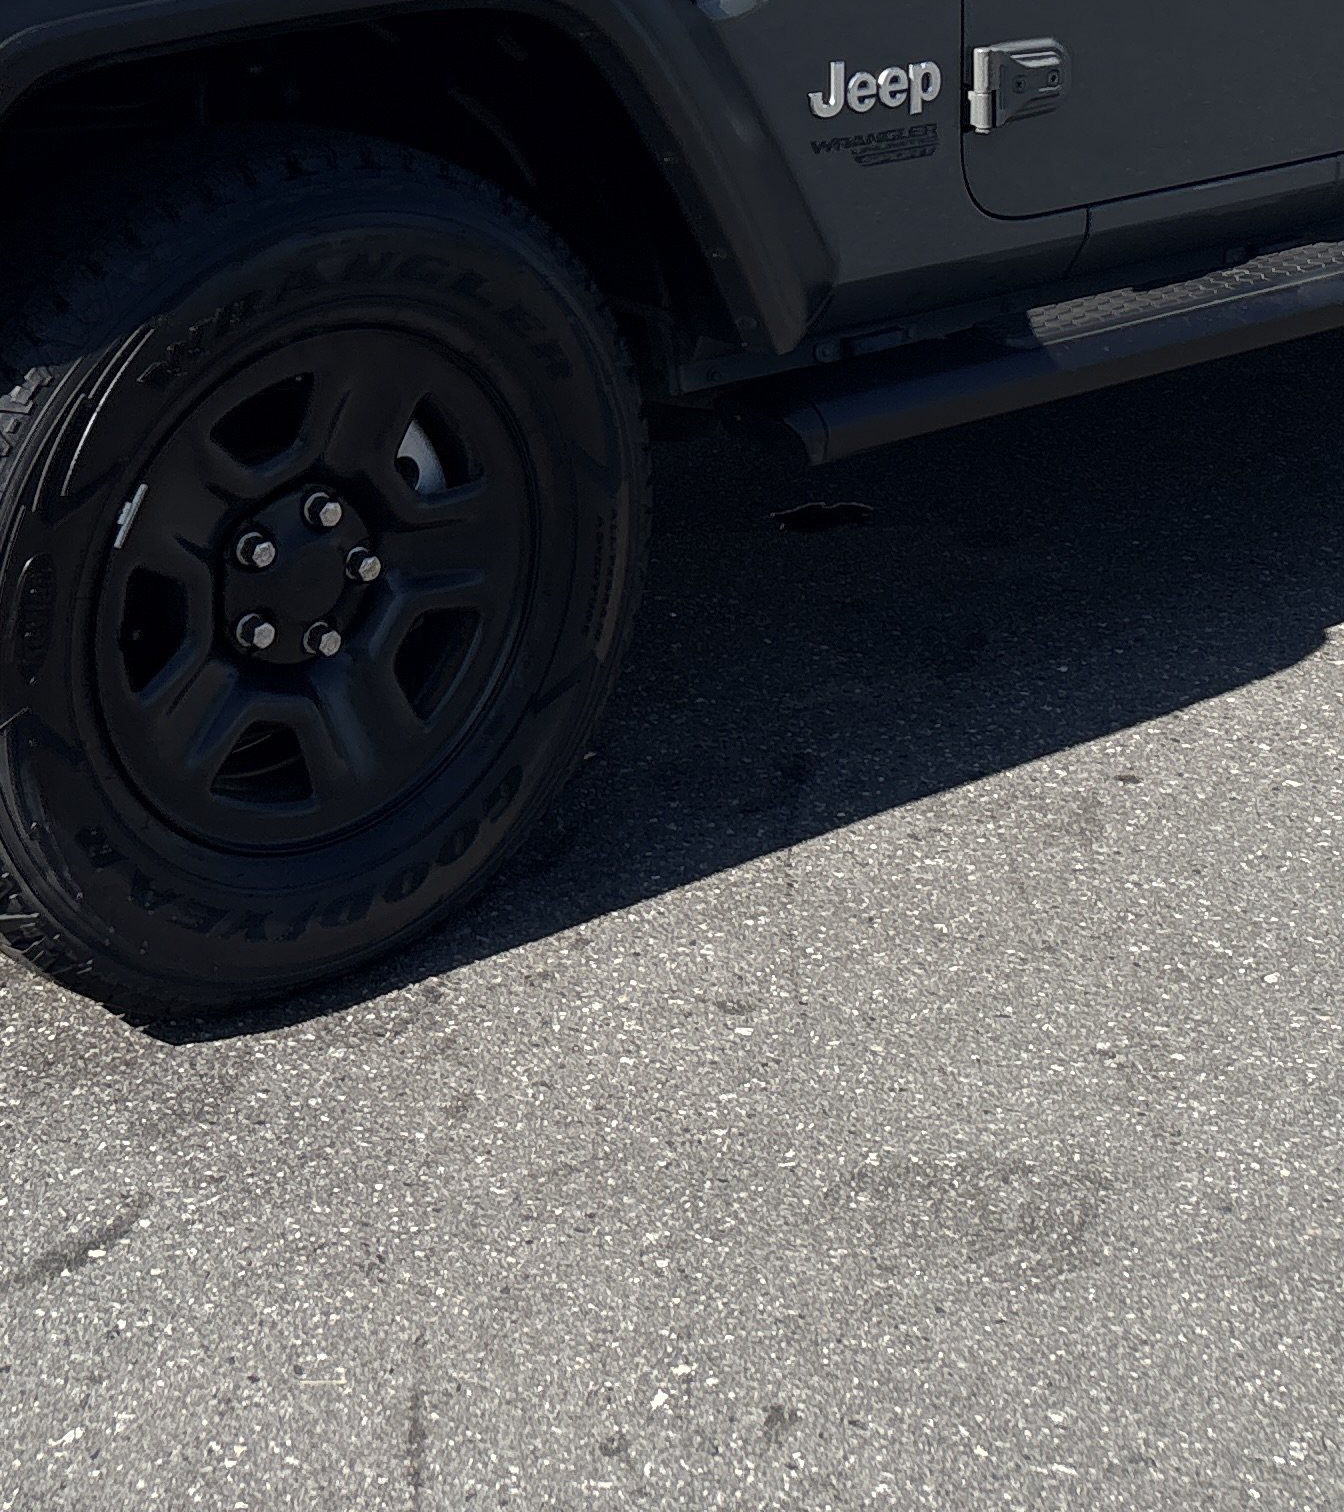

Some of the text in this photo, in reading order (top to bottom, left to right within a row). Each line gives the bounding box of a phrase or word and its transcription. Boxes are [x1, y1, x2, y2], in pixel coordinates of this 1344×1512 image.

[807, 60, 942, 118] Jeep
[810, 123, 938, 154] WRANGLER
[138, 252, 572, 390] WRANGLER
[75, 764, 523, 942] GOODYEAR
